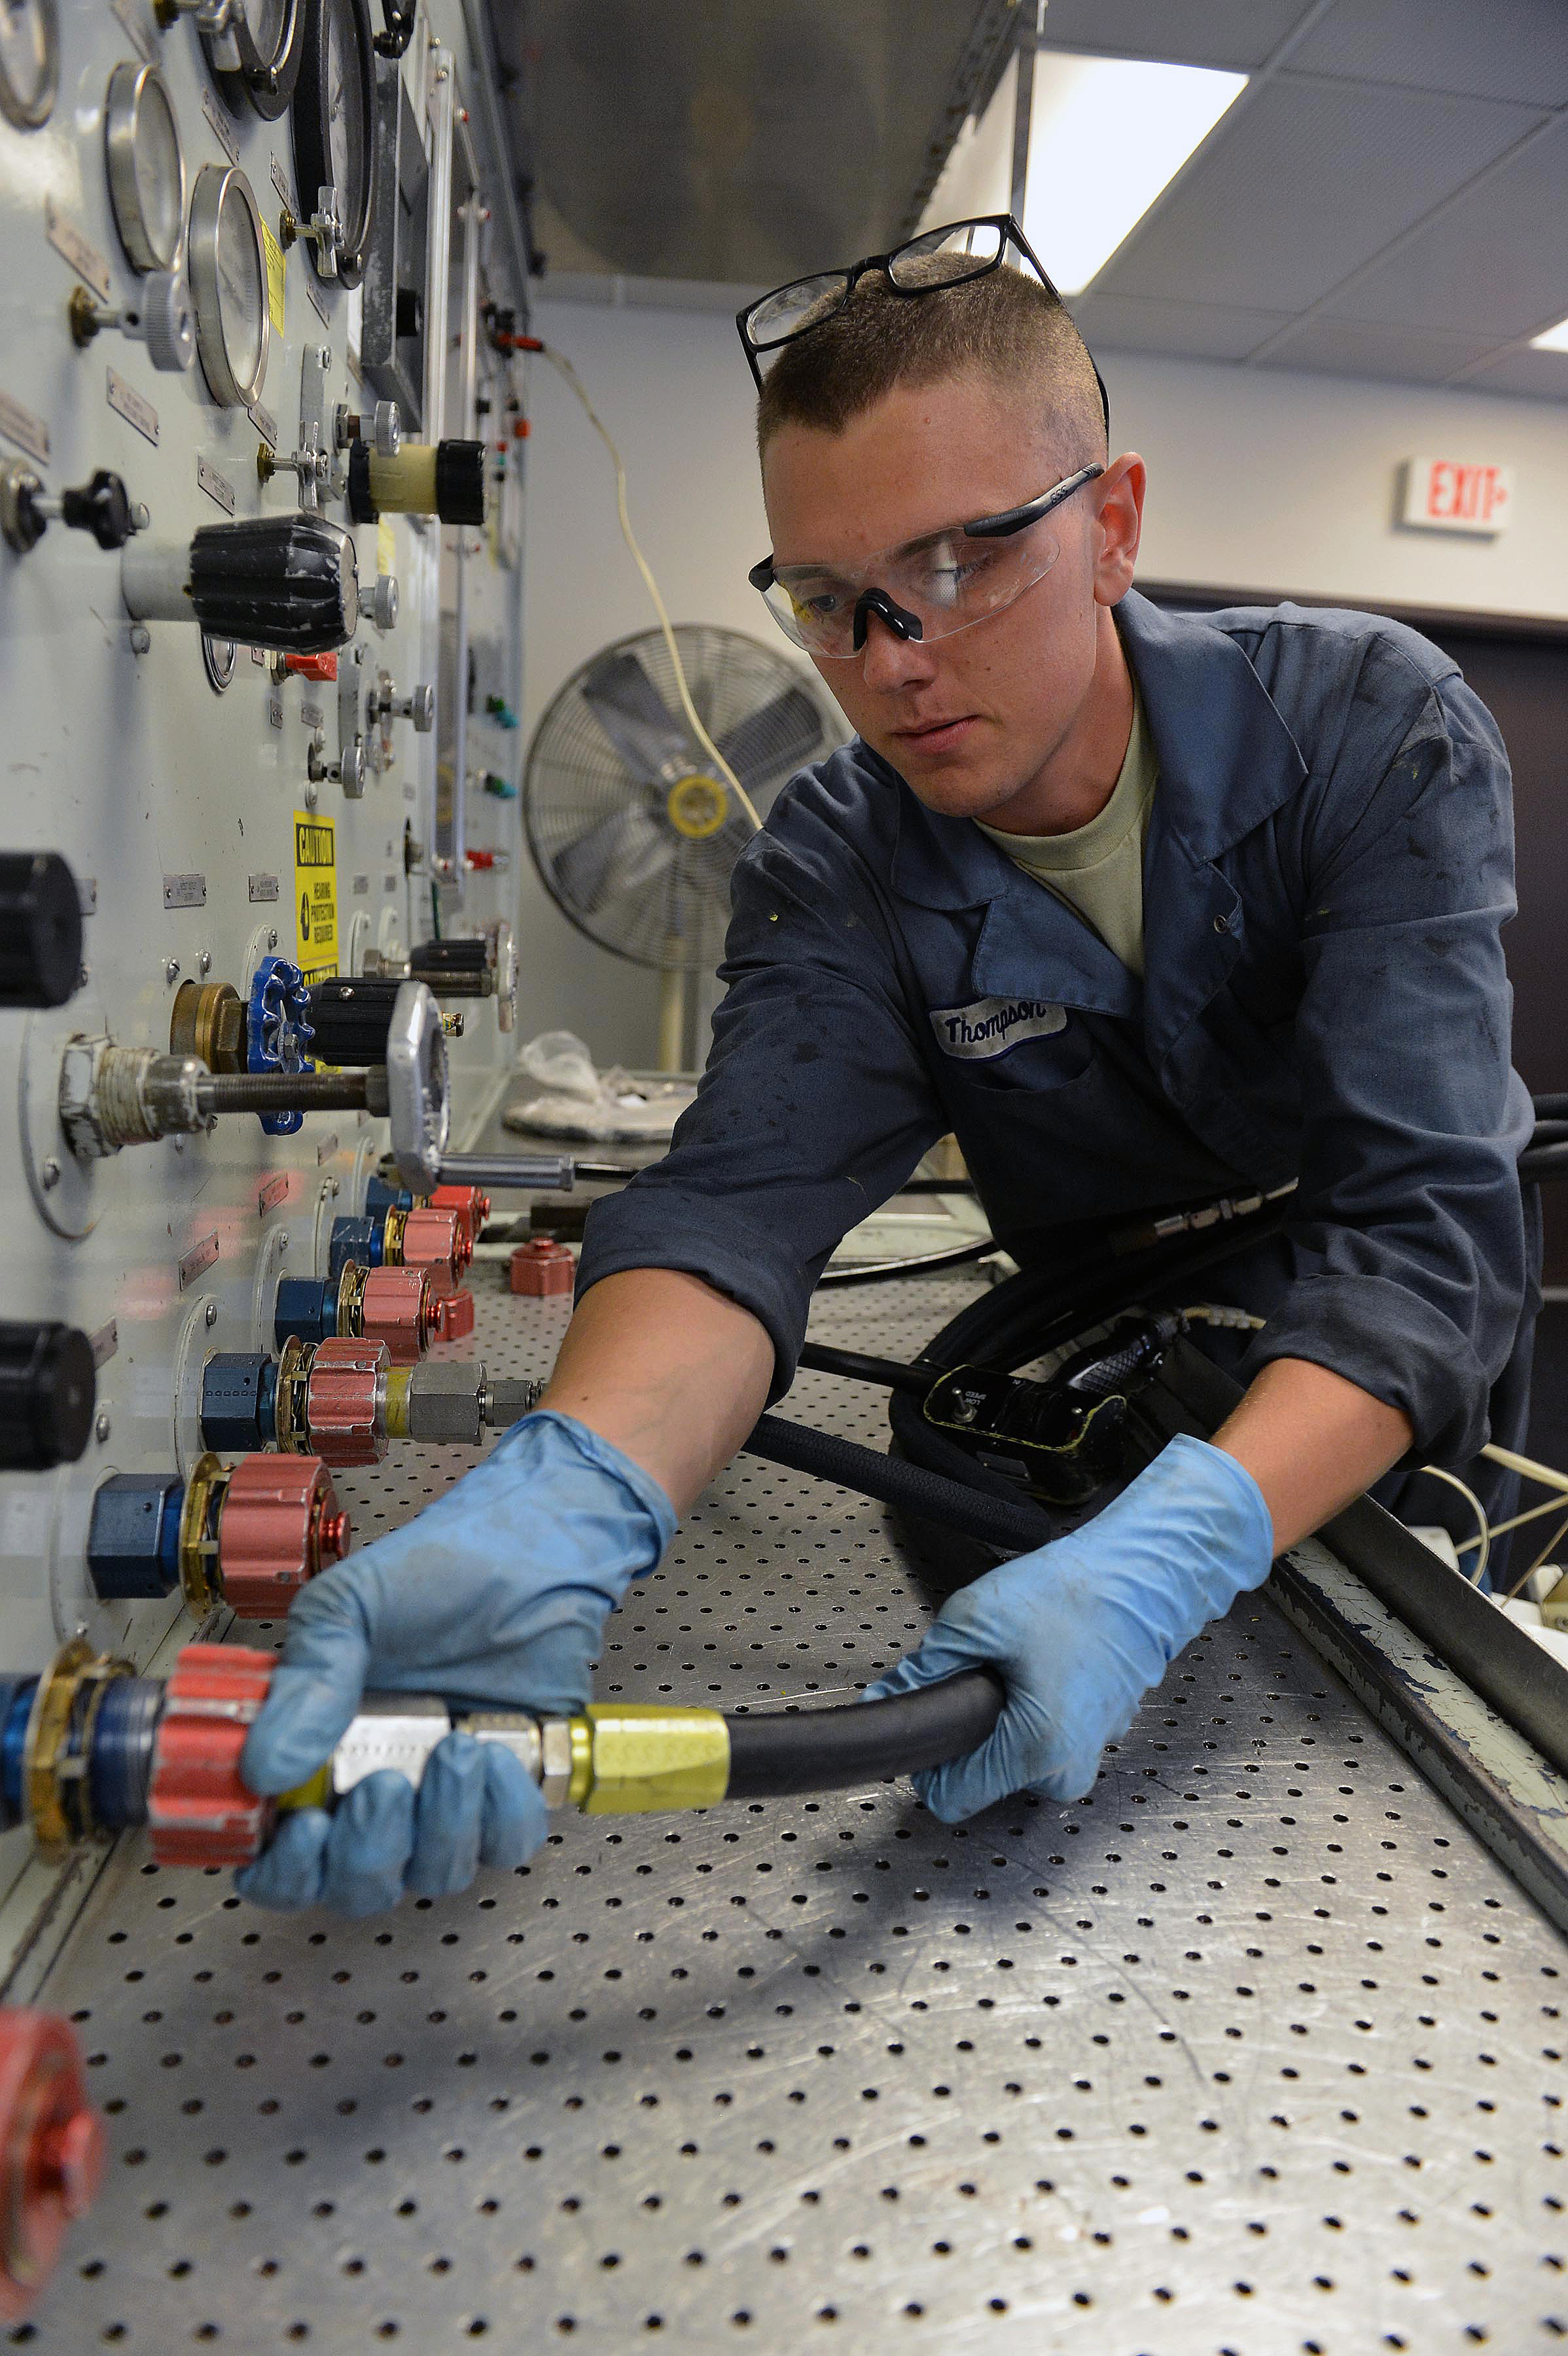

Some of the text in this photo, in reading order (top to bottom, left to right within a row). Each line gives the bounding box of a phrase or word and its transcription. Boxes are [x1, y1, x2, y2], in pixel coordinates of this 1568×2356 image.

[1427, 461, 1500, 521] EXIT
[299, 827, 332, 863] CAUTION
[945, 1001, 1046, 1043] Thompson
[965, 1391, 987, 1400] SPEED
